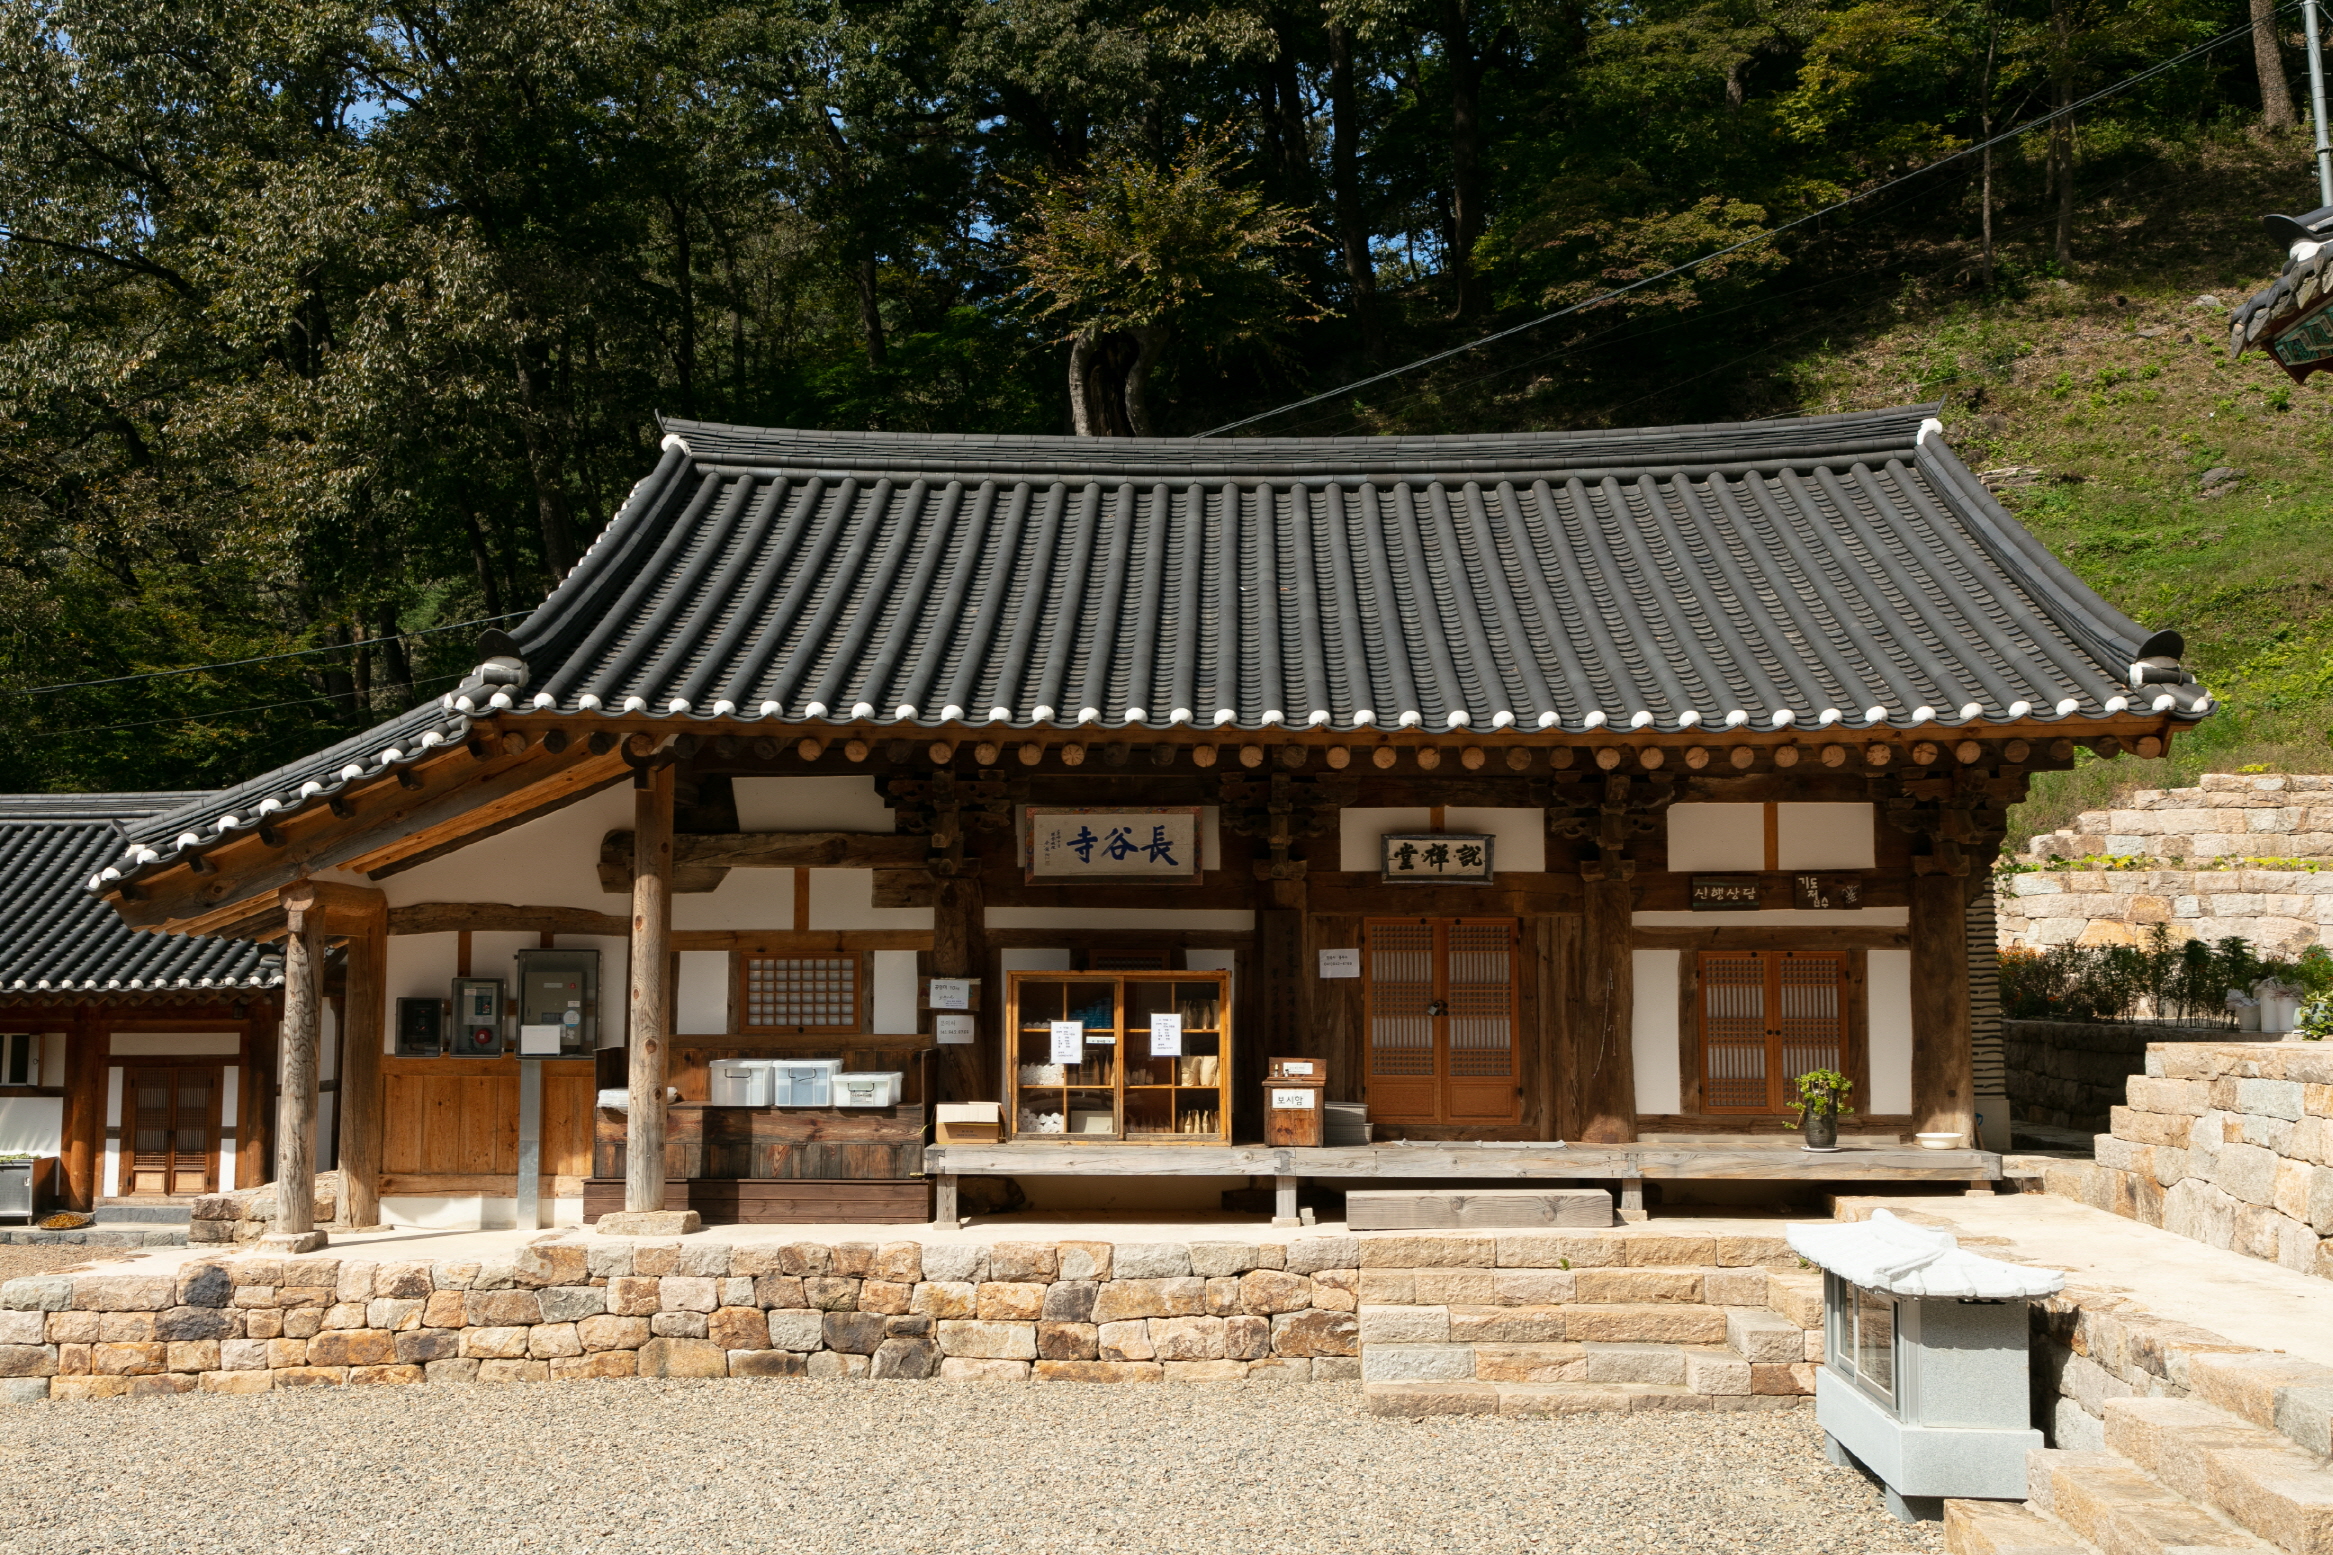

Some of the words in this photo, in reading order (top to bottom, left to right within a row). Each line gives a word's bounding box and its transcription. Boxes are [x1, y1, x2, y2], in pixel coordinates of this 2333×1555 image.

[1798, 876, 1818, 890] 기도
[1694, 887, 1756, 901] 신행상담
[1807, 889, 1829, 909] 접수
